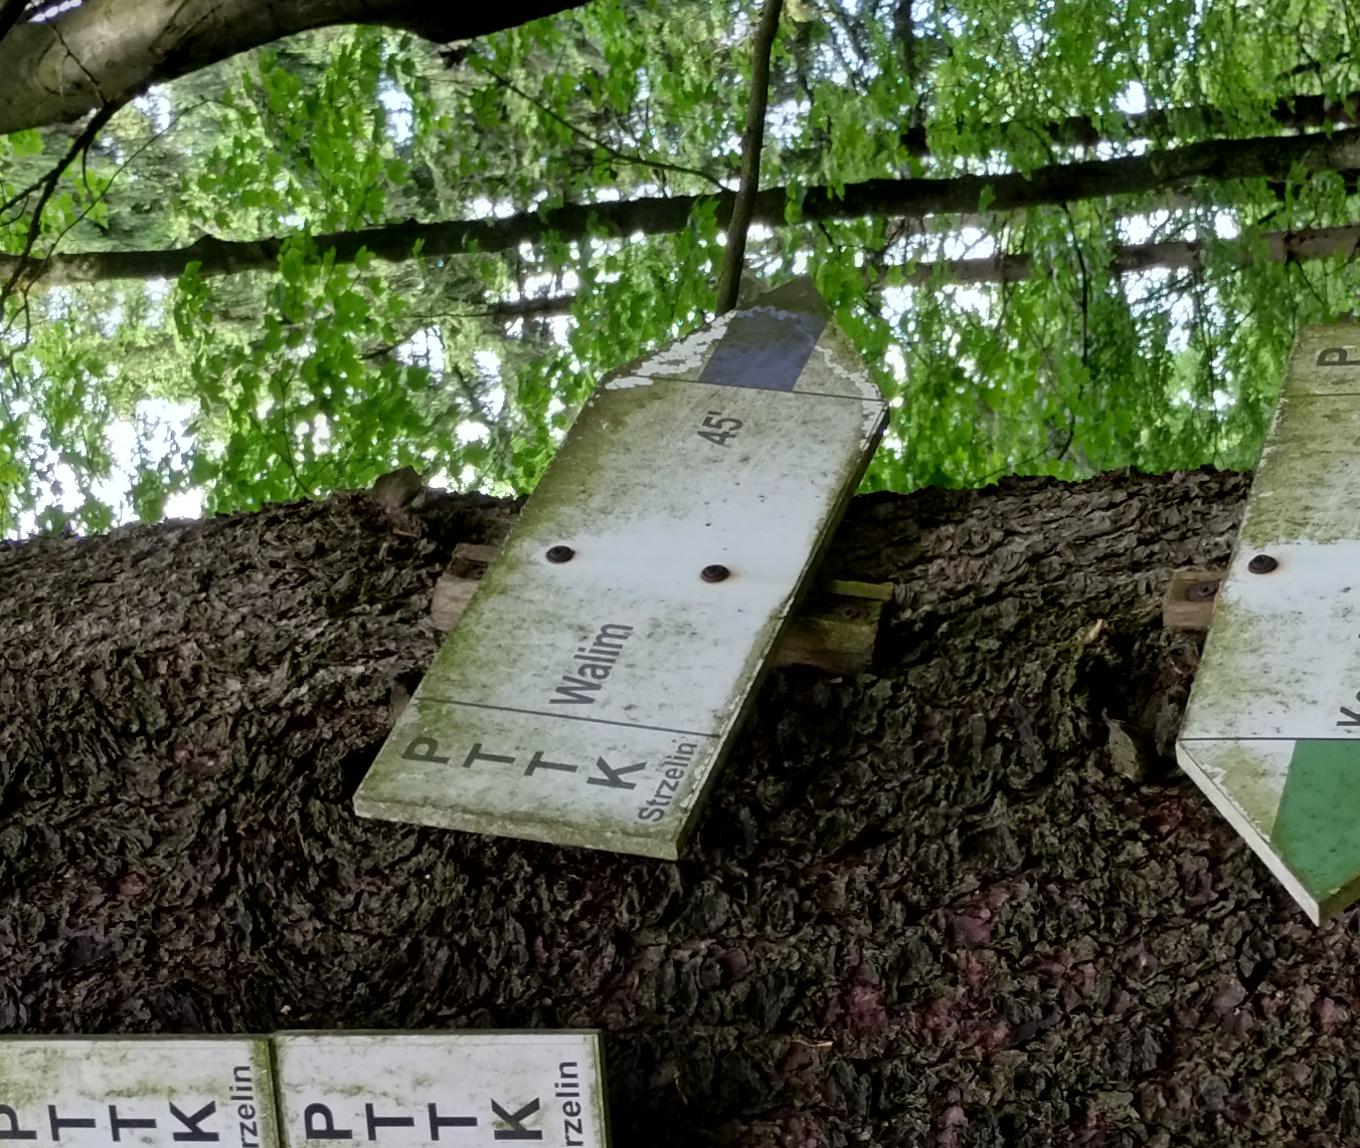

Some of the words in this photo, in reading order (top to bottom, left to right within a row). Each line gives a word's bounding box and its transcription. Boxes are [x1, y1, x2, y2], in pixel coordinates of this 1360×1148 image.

[549, 623, 634, 705] Walim
[695, 411, 743, 446] 45'
[637, 743, 698, 822] Strzelin
